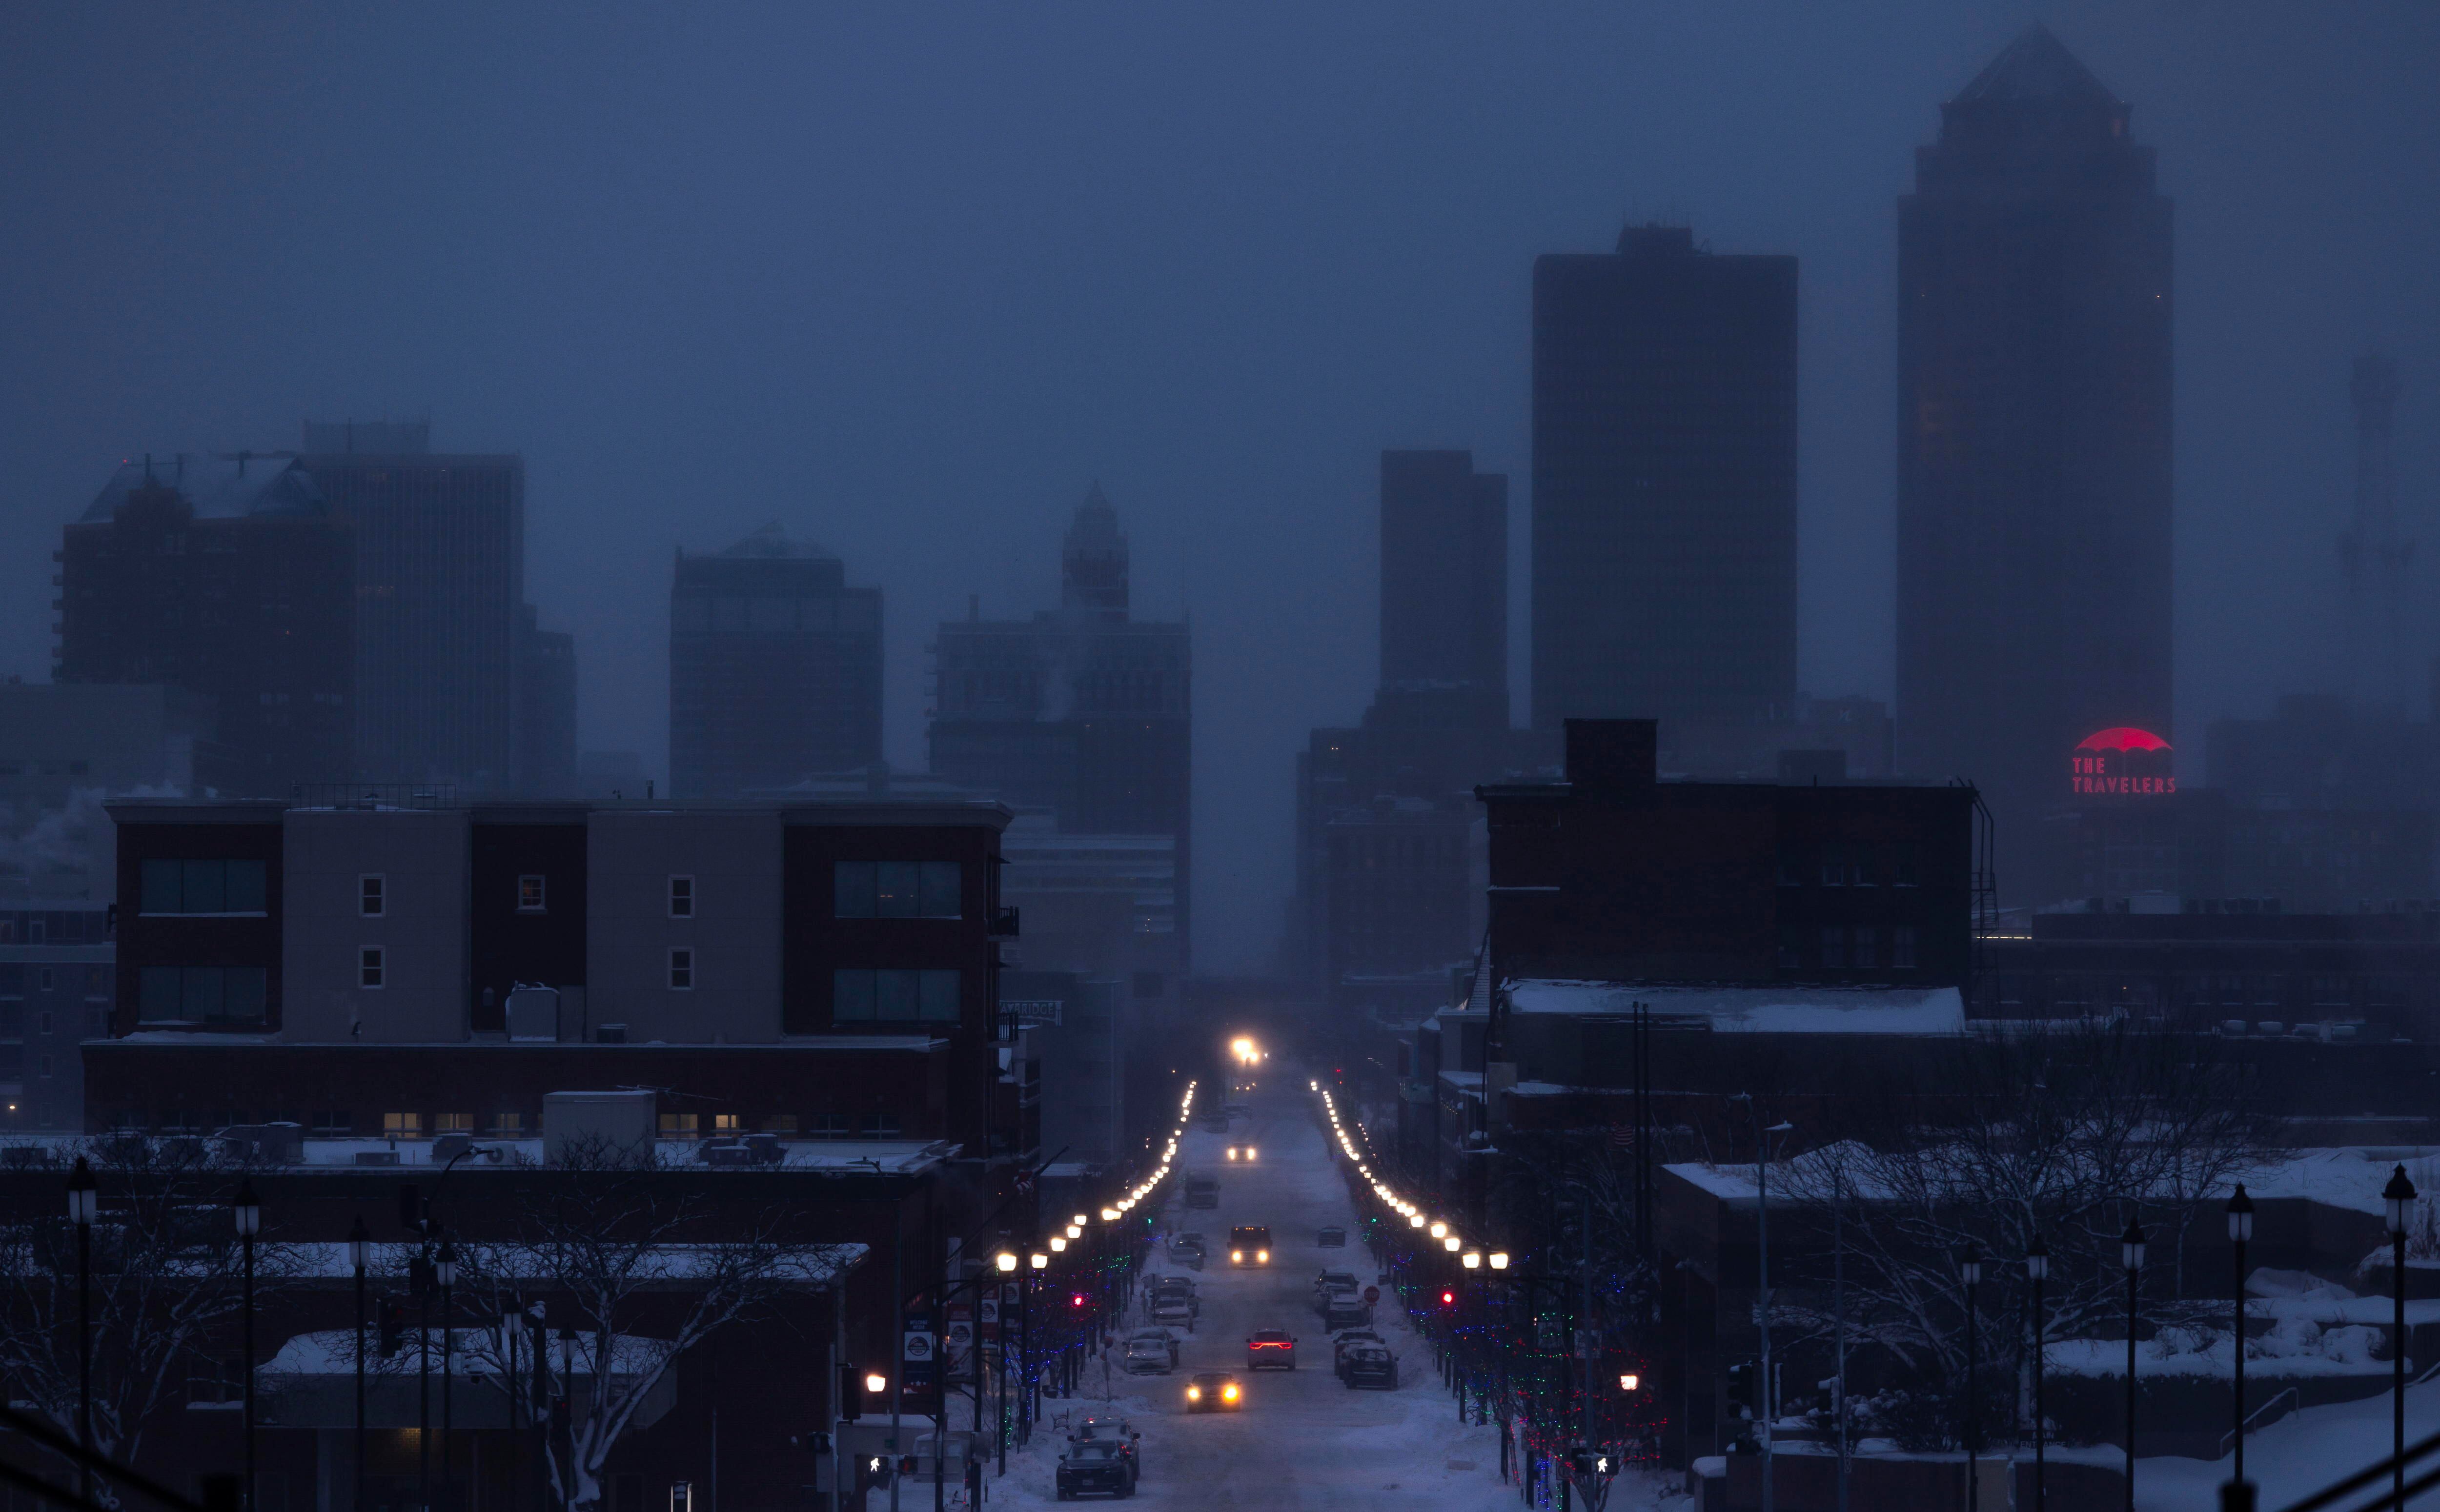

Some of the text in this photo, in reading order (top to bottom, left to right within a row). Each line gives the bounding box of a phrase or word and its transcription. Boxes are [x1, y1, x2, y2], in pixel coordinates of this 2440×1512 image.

[2073, 757, 2105, 773] THE
[2073, 777, 2176, 793] TRAVELERS
[999, 1003, 1054, 1014] AYBRIDGE
